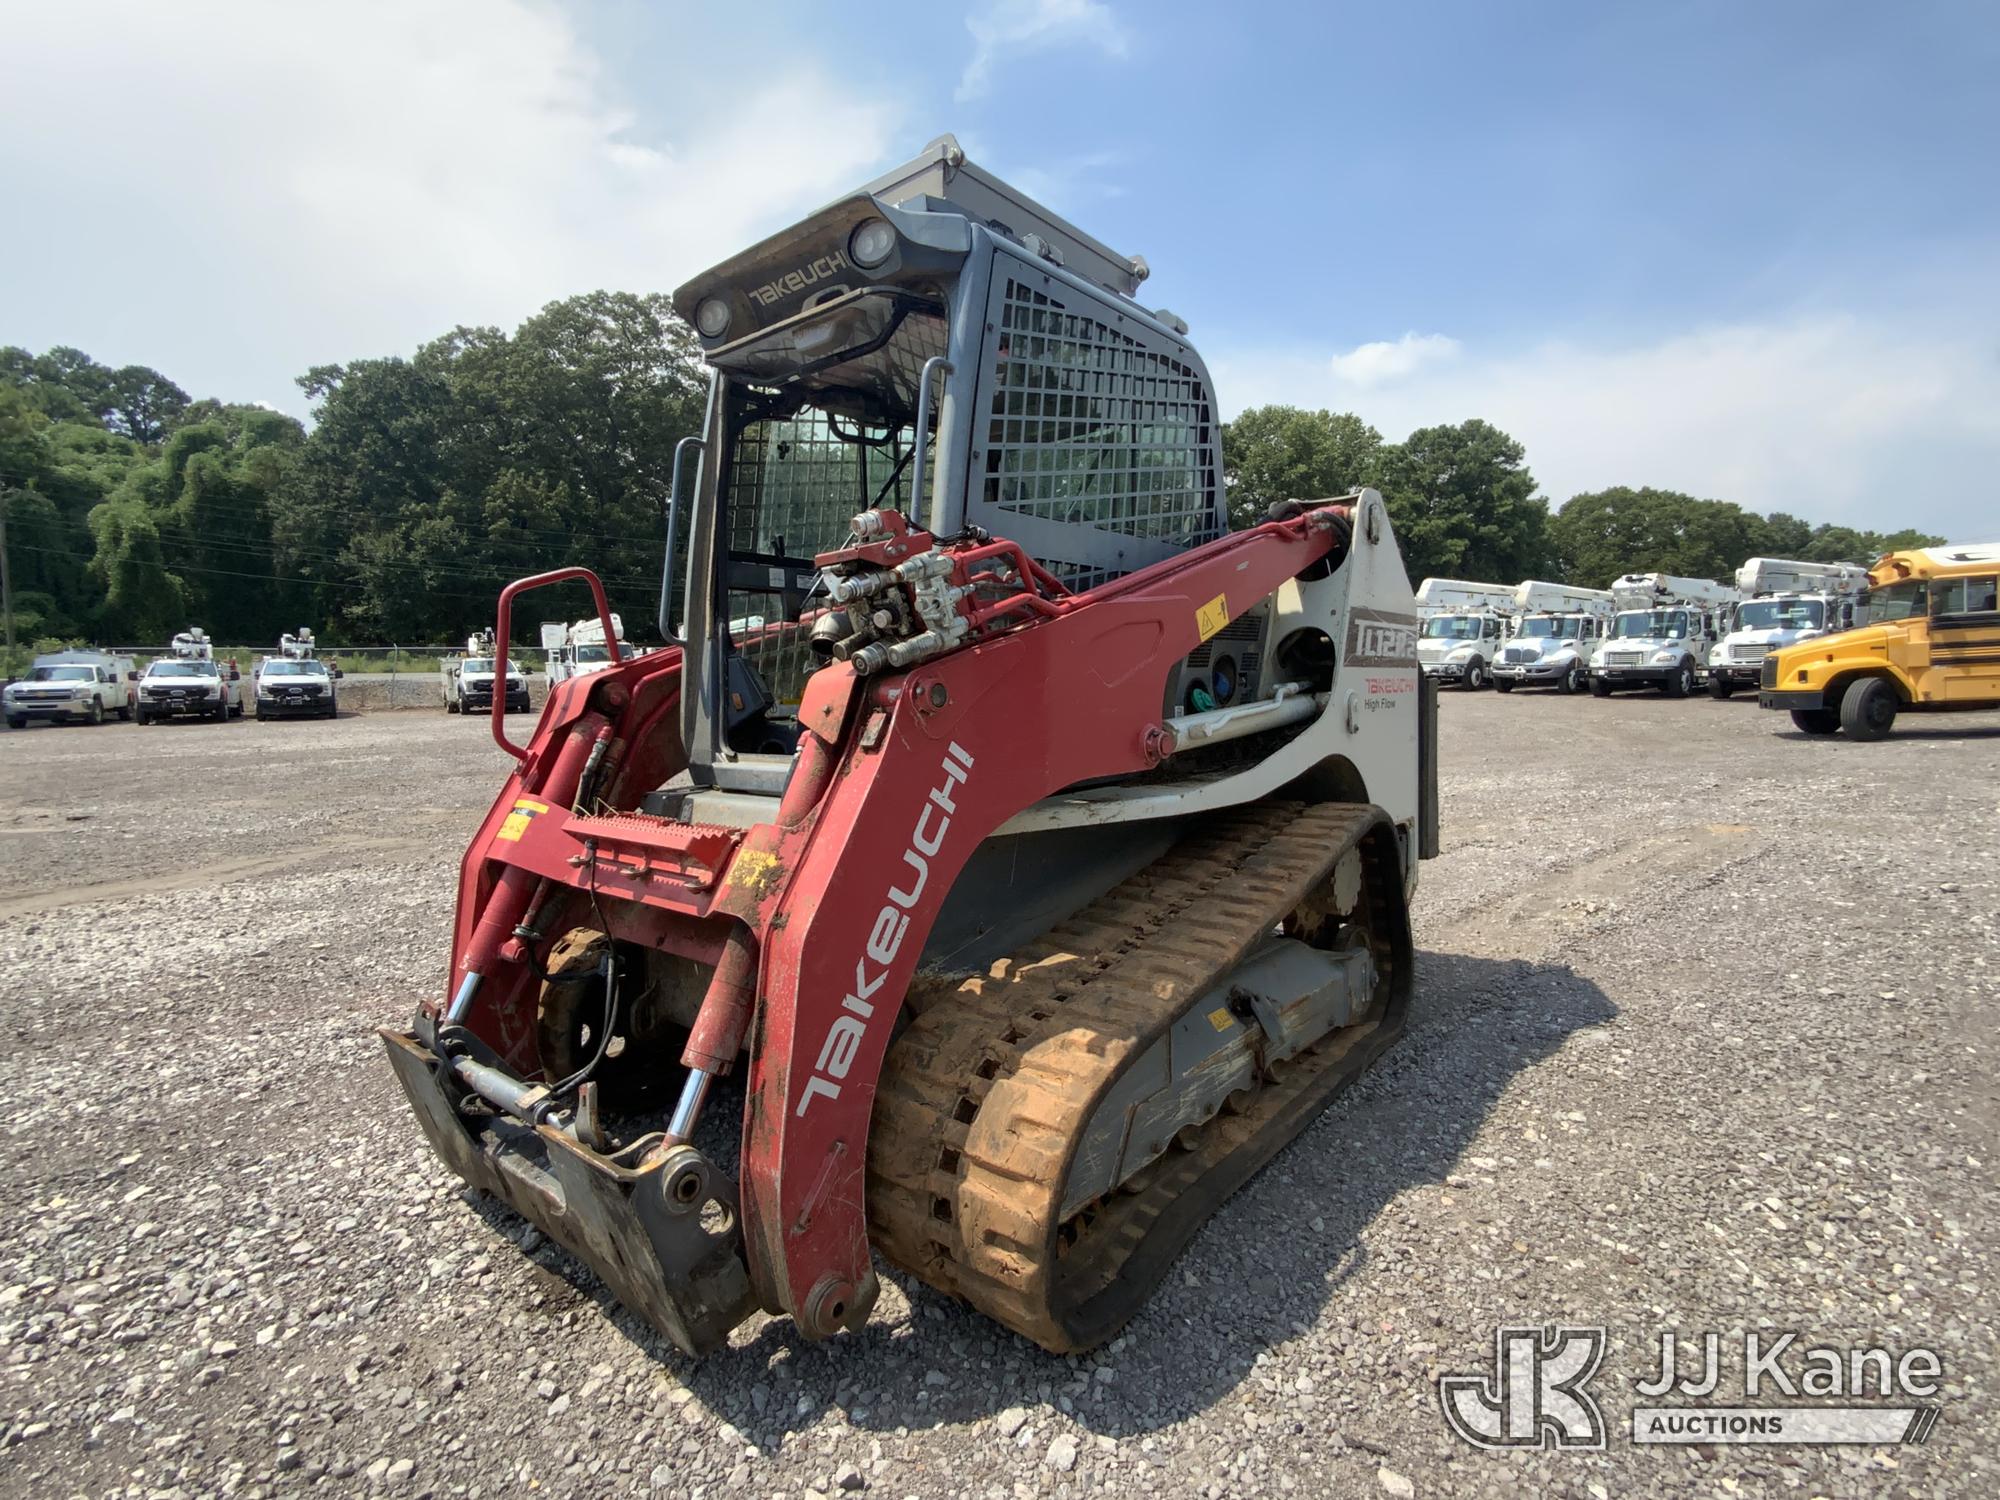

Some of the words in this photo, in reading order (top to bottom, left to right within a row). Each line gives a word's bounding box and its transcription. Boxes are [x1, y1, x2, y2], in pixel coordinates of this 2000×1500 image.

[749, 249, 850, 307] TAKEUCHI
[1364, 698, 1380, 712] High
[1381, 698, 1396, 709] Flow
[796, 740, 975, 1118] TAKEUCHI
